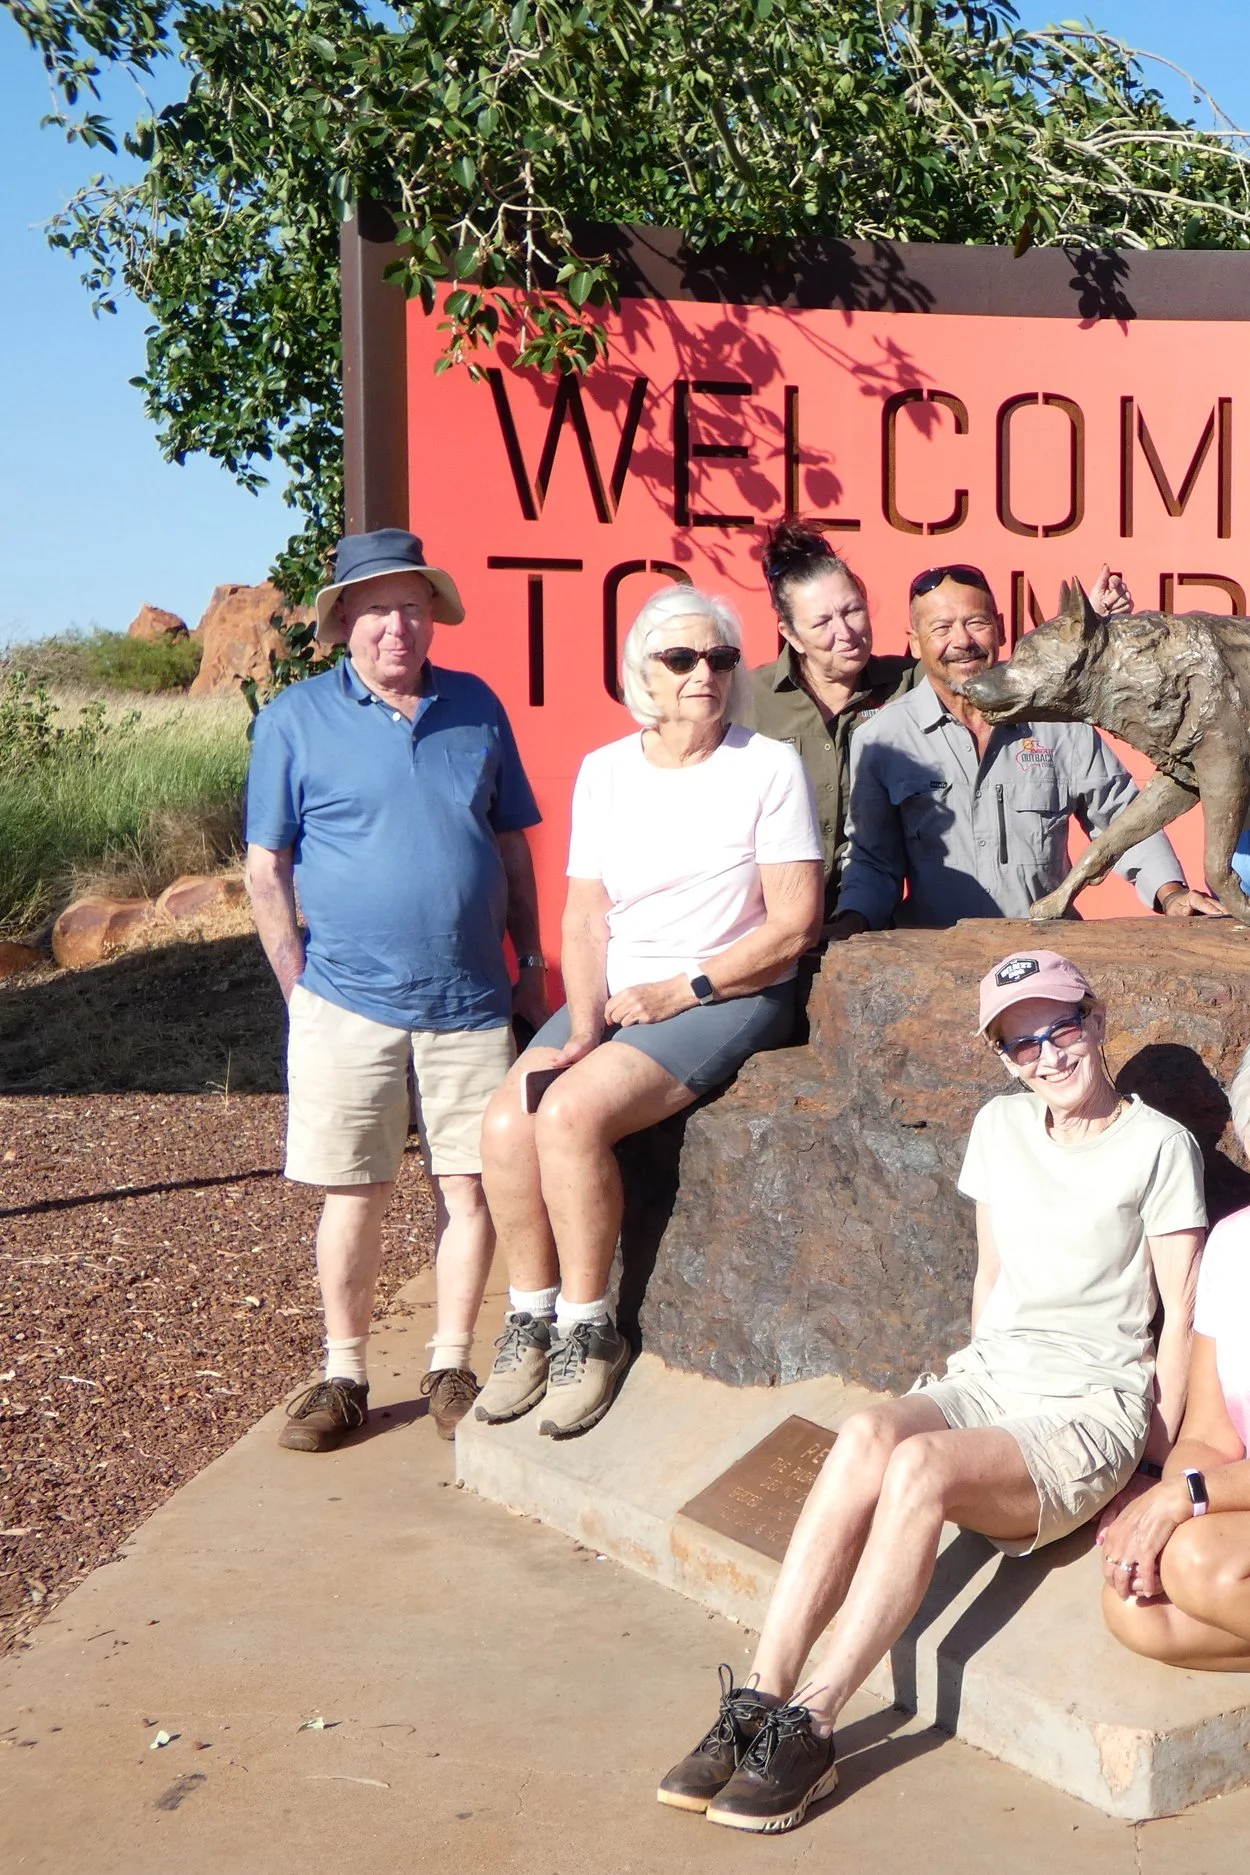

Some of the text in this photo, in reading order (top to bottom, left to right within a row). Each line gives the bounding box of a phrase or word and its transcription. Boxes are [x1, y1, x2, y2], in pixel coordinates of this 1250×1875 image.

[487, 556, 694, 708] TO
[1021, 753, 1054, 763] OUTBACK
[770, 1456, 792, 1473] THE
[728, 1486, 763, 1508] ERECTED
